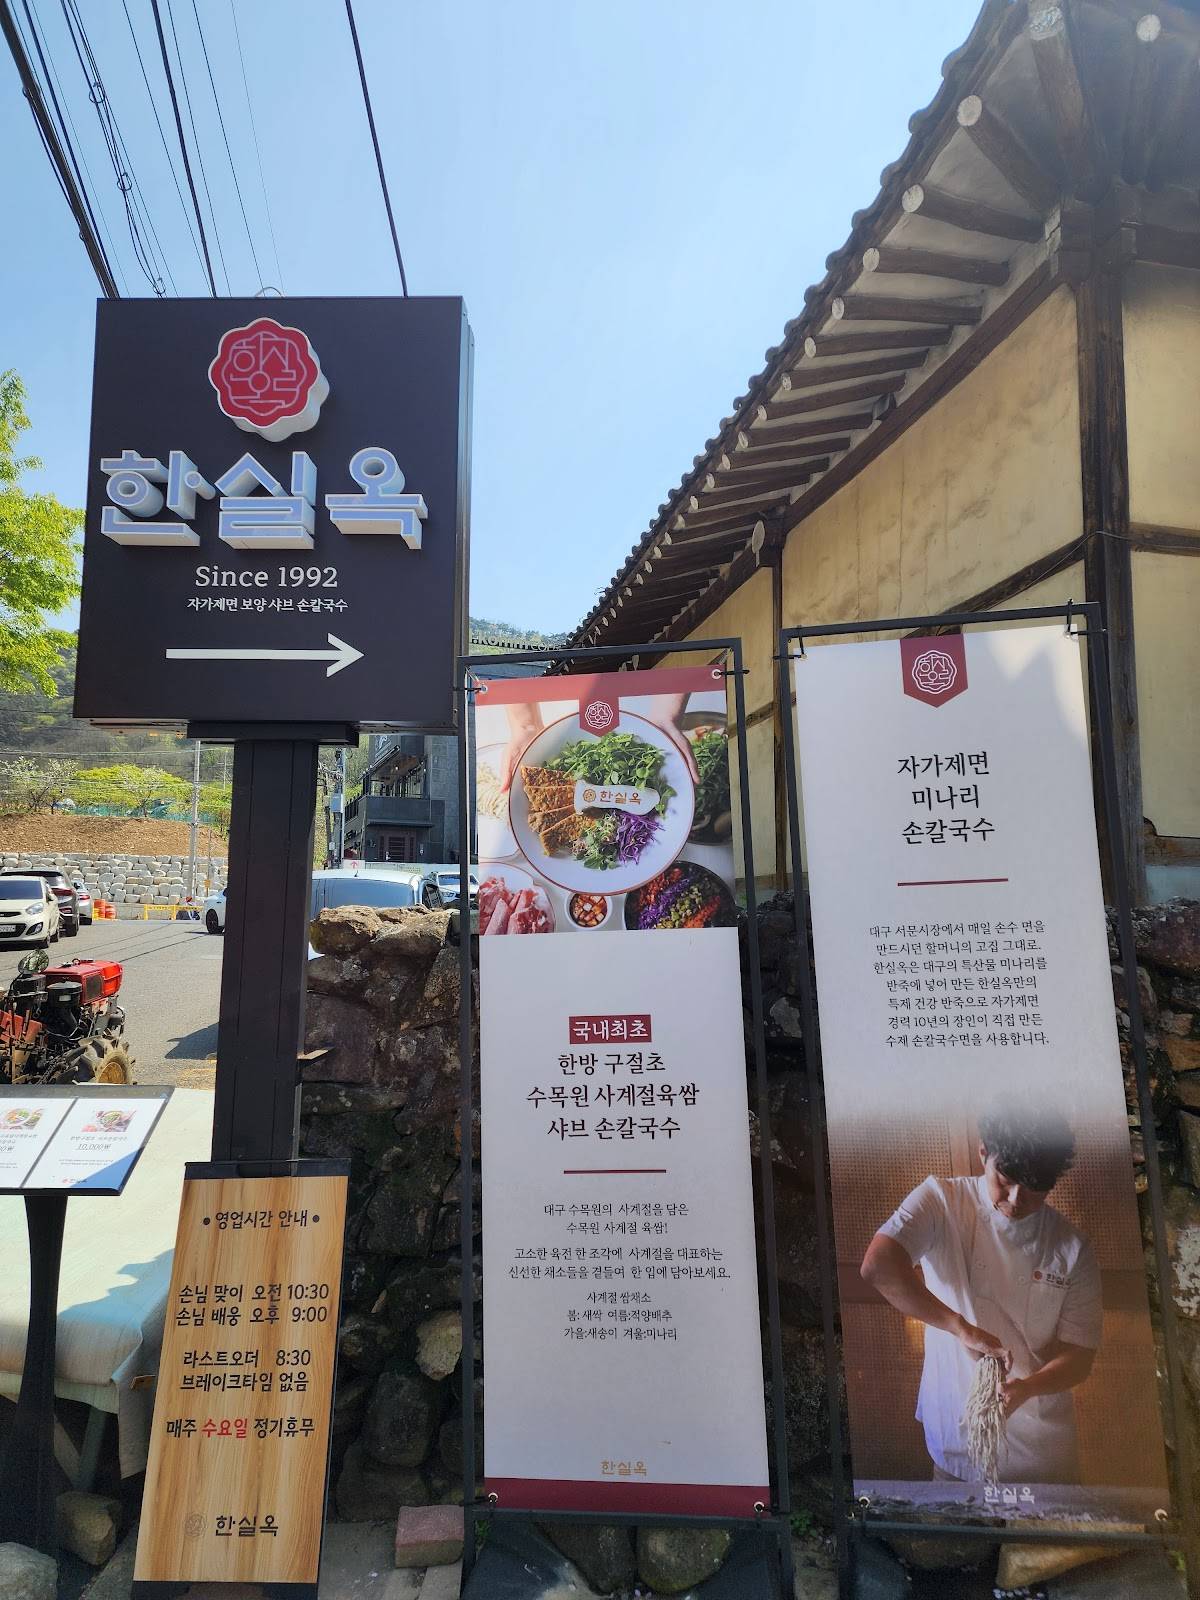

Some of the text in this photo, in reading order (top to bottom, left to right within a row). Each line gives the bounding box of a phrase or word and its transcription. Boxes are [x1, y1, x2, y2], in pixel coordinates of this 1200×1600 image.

[100, 446, 428, 550] 한실옥
[195, 565, 337, 587] Since 1992
[187, 597, 348, 612] 자가제면 보양 샤브 손칼국수
[897, 751, 990, 779] 자가제면
[600, 791, 641, 805] 한실옥
[912, 785, 979, 811] 미나리
[902, 817, 995, 844] 손칼국수
[870, 920, 1045, 938] 대구 서문시장에서 매일 손수 면을
[876, 943, 922, 956] 만드시던
[926, 941, 972, 954] 할머니의
[976, 940, 998, 952] 고집
[873, 957, 1047, 974] 한실옥은 대구의 특산물 미나리를
[887, 976, 1037, 992] 반죽에 넣어 만든 한실옥만의
[888, 995, 1039, 1010] 특제 건강 반죽으로 자가제면
[573, 1019, 649, 1041] 국내최초
[889, 1013, 1043, 1029] 경력 10년의 장인이 직접 만든
[886, 1032, 1049, 1048] 수제 손칼국수면을 사용합니다.
[558, 1053, 666, 1075] 한방 구절초
[526, 1083, 700, 1109] 수목원 사계절육쌈
[547, 1117, 681, 1140] 샤브 손칼국수
[215, 1210, 308, 1229] 영업시간 안내
[544, 1204, 689, 1216] 대구 수목원의 사계절을 담은
[567, 1222, 668, 1234] 수목원 사계절 육쌈!
[514, 1248, 723, 1260] 고소한 육전 한 조각에 사계절을 대표하는
[508, 1266, 541, 1279] 신선한
[544, 1266, 588, 1279] 채소들을
[631, 1266, 642, 1279] 한
[646, 1266, 667, 1279] 입에
[179, 1283, 329, 1303] 손님 맞이 오전 10:30
[587, 1292, 652, 1304] 사계절 쌈채소
[176, 1305, 328, 1326] 손님 배웅 오후 9:00
[183, 1349, 310, 1368] 라스트오더 8:30
[180, 1372, 309, 1392] 브레이크타임 없음
[166, 1417, 315, 1439] 매주 수요일 정기휴무
[600, 1460, 647, 1476] 한실옥
[983, 1484, 1035, 1505] 한실옥
[216, 1515, 278, 1537] 한실옥
